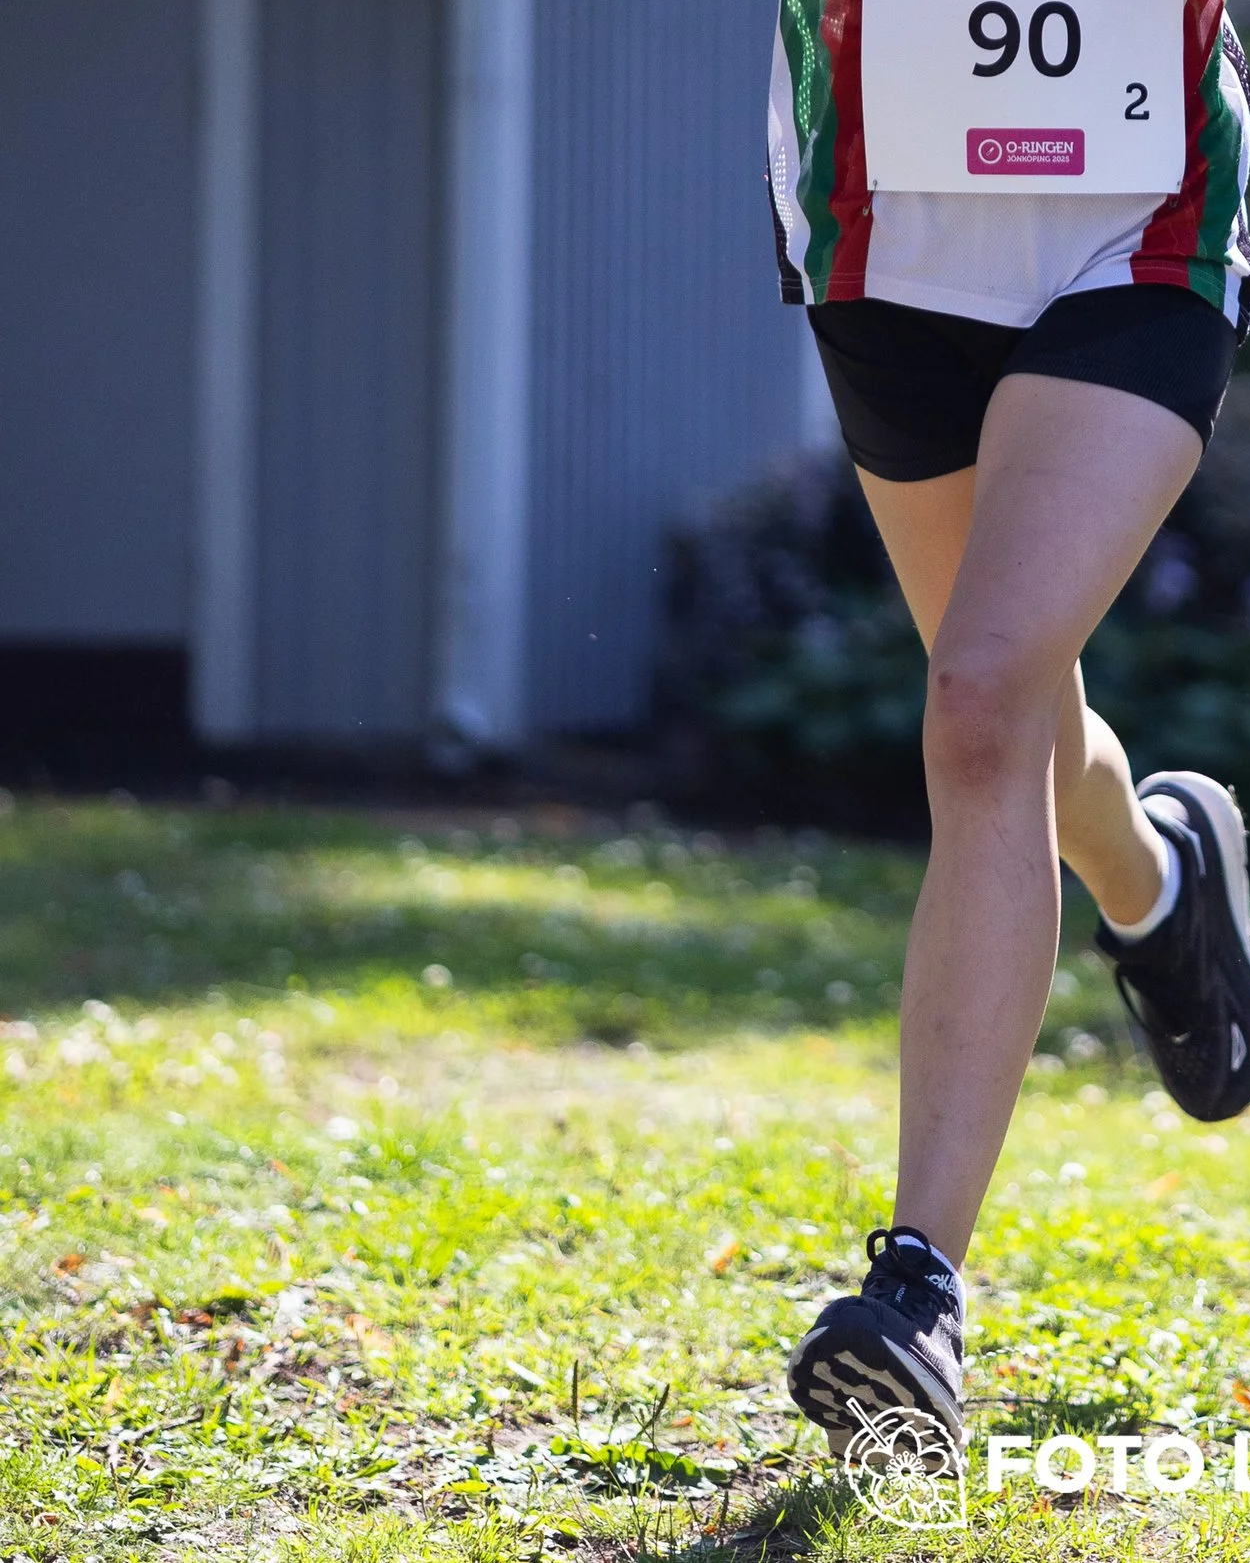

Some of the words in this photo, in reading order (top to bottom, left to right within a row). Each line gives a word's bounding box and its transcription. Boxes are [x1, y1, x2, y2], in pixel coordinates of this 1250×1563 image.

[968, 0, 1081, 78] 90
[1124, 82, 1150, 120] 2
[1006, 141, 1074, 154] O-RINGEN
[1006, 154, 1051, 163] JÖNKÖPING
[1052, 155, 1070, 163] 2025
[924, 1274, 957, 1293] OKA
